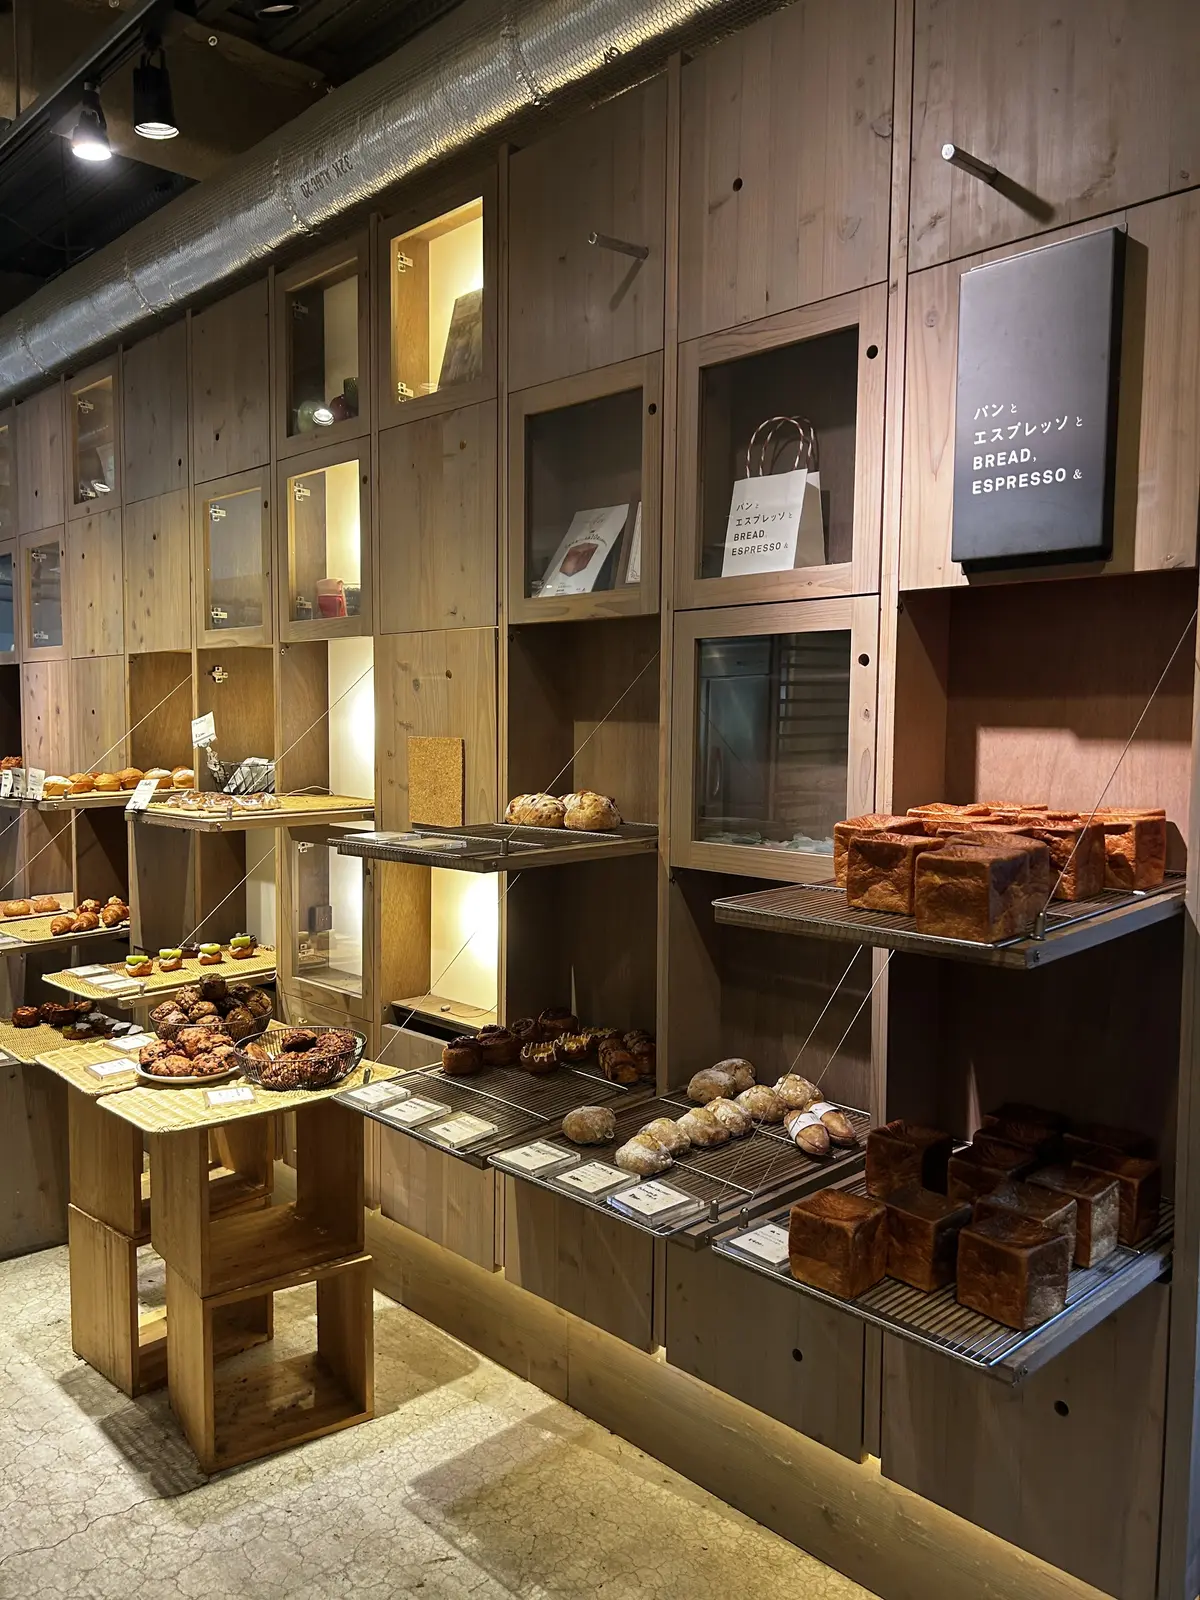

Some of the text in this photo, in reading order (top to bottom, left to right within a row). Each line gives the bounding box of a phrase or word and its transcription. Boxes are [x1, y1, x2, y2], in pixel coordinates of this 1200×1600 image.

[973, 403, 1018, 420] パンと
[973, 415, 1083, 445] エスプレッソと
[972, 448, 1036, 471] BREAD,
[972, 467, 1083, 495] ESPRESSO &
[731, 541, 781, 556] ESPRESSO
